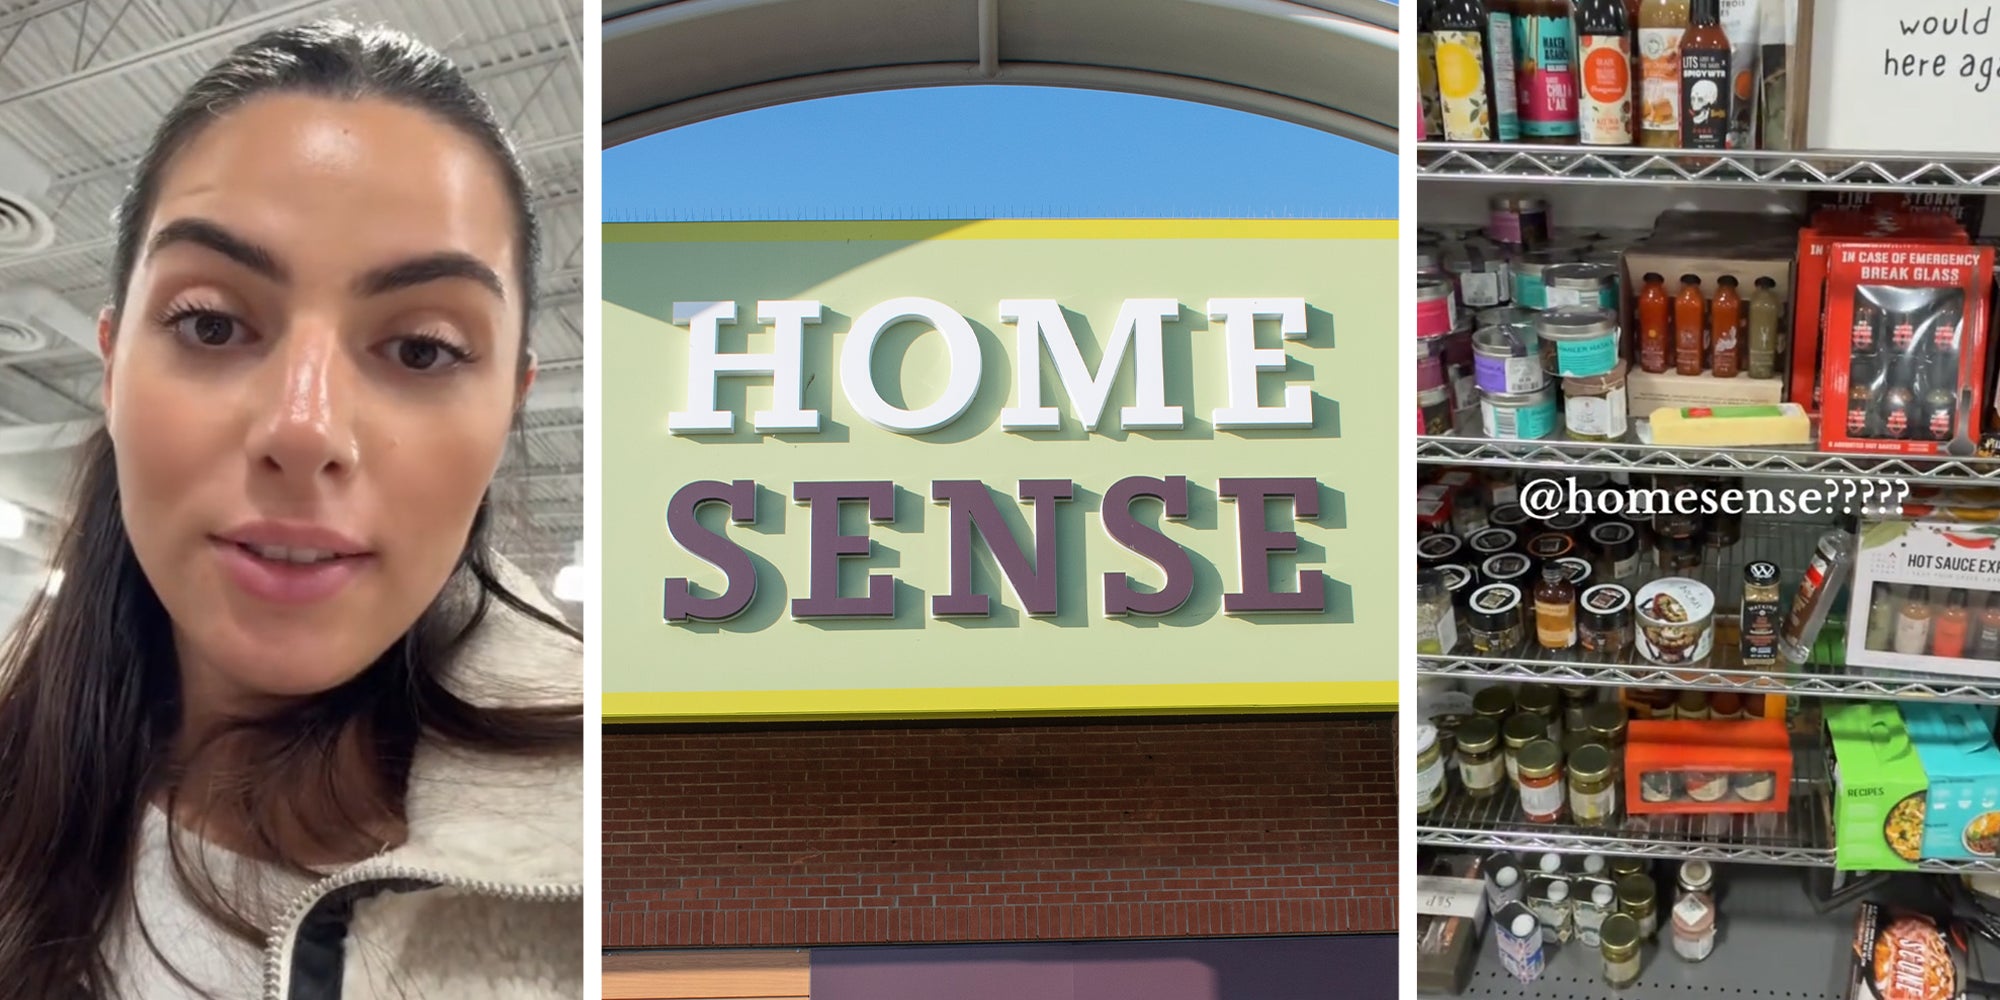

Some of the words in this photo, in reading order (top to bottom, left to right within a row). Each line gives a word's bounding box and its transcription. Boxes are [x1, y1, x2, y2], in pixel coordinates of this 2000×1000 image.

[1900, 6, 1991, 35] would
[1683, 56, 1699, 69] LITS
[1884, 48, 1946, 77] here
[1959, 53, 2000, 92] ag
[1901, 192, 1960, 206] STORM
[1811, 244, 1823, 255] IN
[1842, 252, 1856, 263] IN
[1858, 252, 1889, 264] CASE
[1892, 253, 1908, 264] OF
[1909, 253, 1980, 266] EMERGENCY
[1861, 266, 1909, 280] BREAK
[1913, 267, 1960, 281] GLASS
[668, 296, 1314, 436] HOME
[663, 475, 1325, 623] SENSE
[1907, 554, 1933, 569] HOT
[1934, 555, 1977, 572] SAUCE
[1847, 787, 1884, 797] RECIPES
